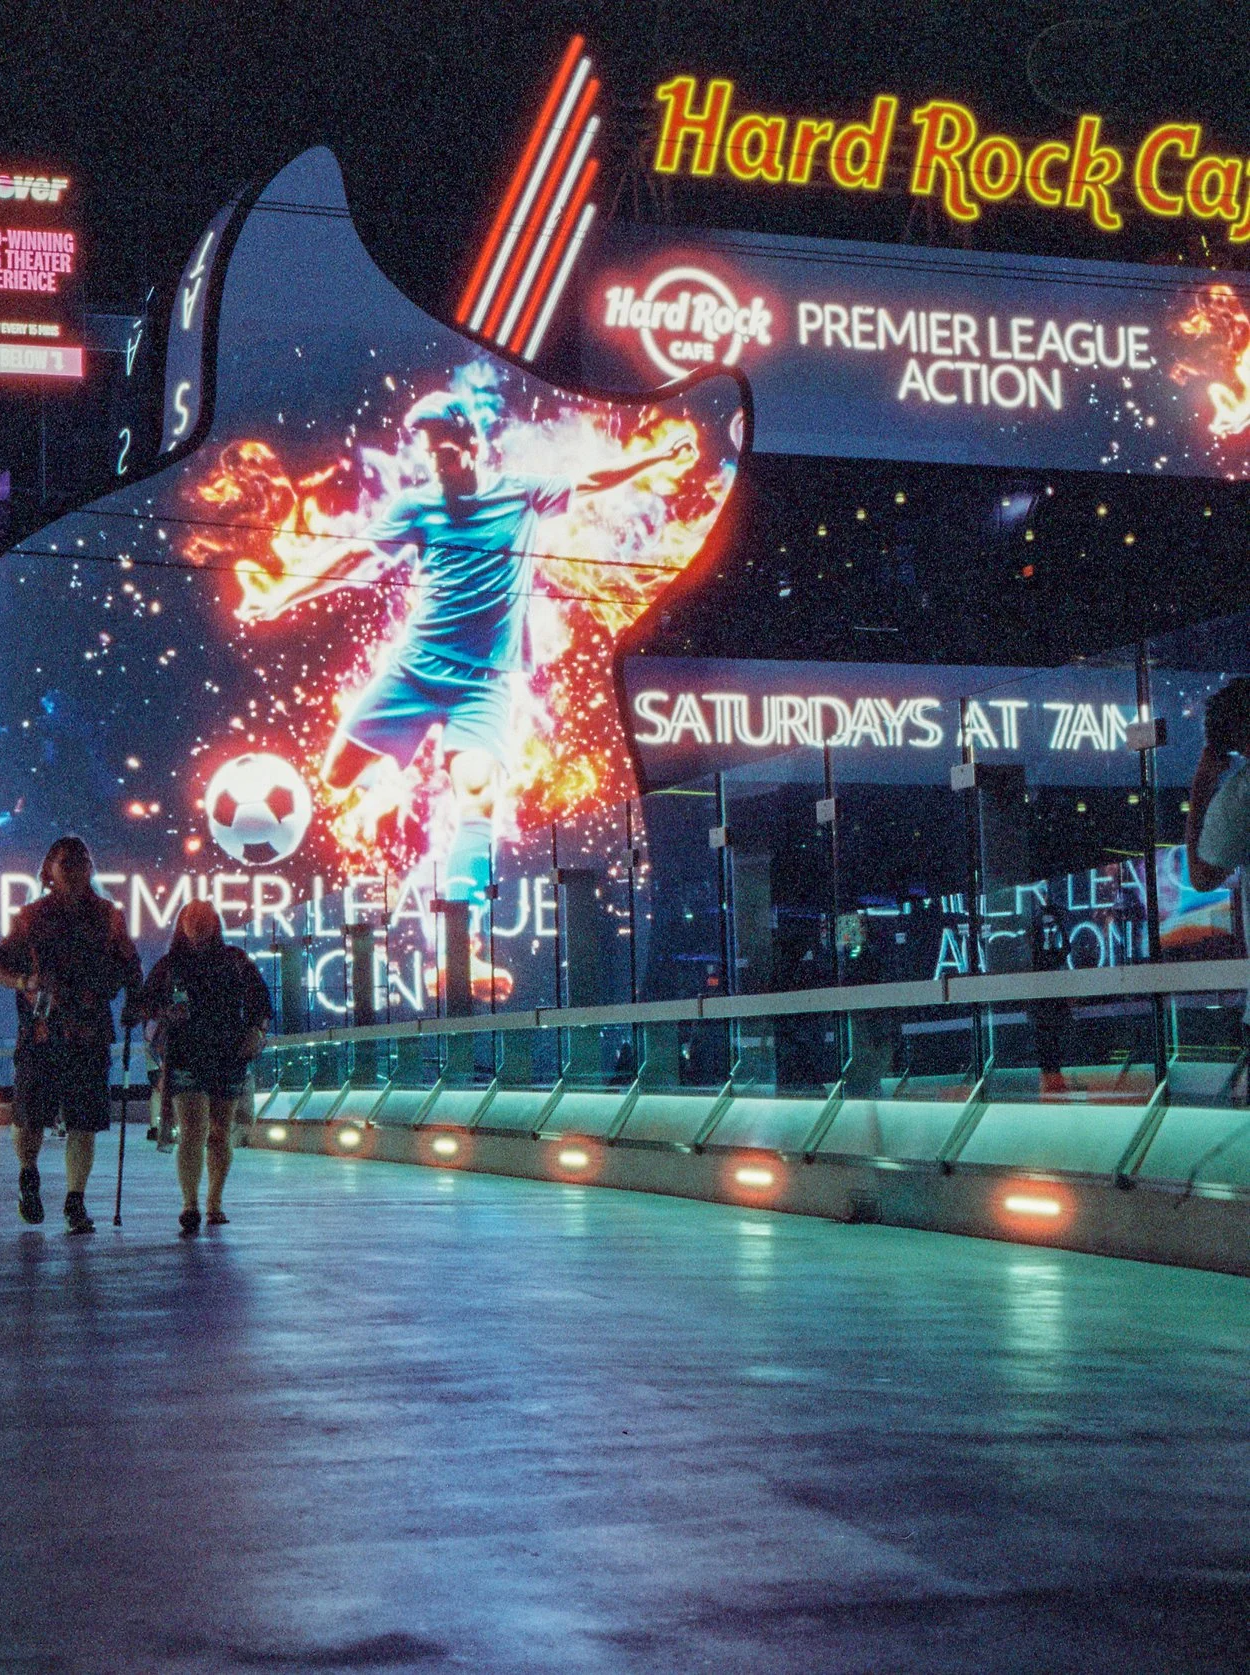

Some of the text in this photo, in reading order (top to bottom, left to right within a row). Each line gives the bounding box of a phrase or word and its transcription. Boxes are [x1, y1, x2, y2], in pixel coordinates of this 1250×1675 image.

[656, 75, 898, 191] Hard
[912, 101, 1122, 231] Rock
[5, 250, 71, 273] THEATER
[605, 286, 773, 345] Hard Rock
[798, 302, 1152, 370] PREMIER LEAGUE
[897, 359, 1063, 411] ACTION
[634, 690, 1150, 751] SATURDAYS AT 7AM
